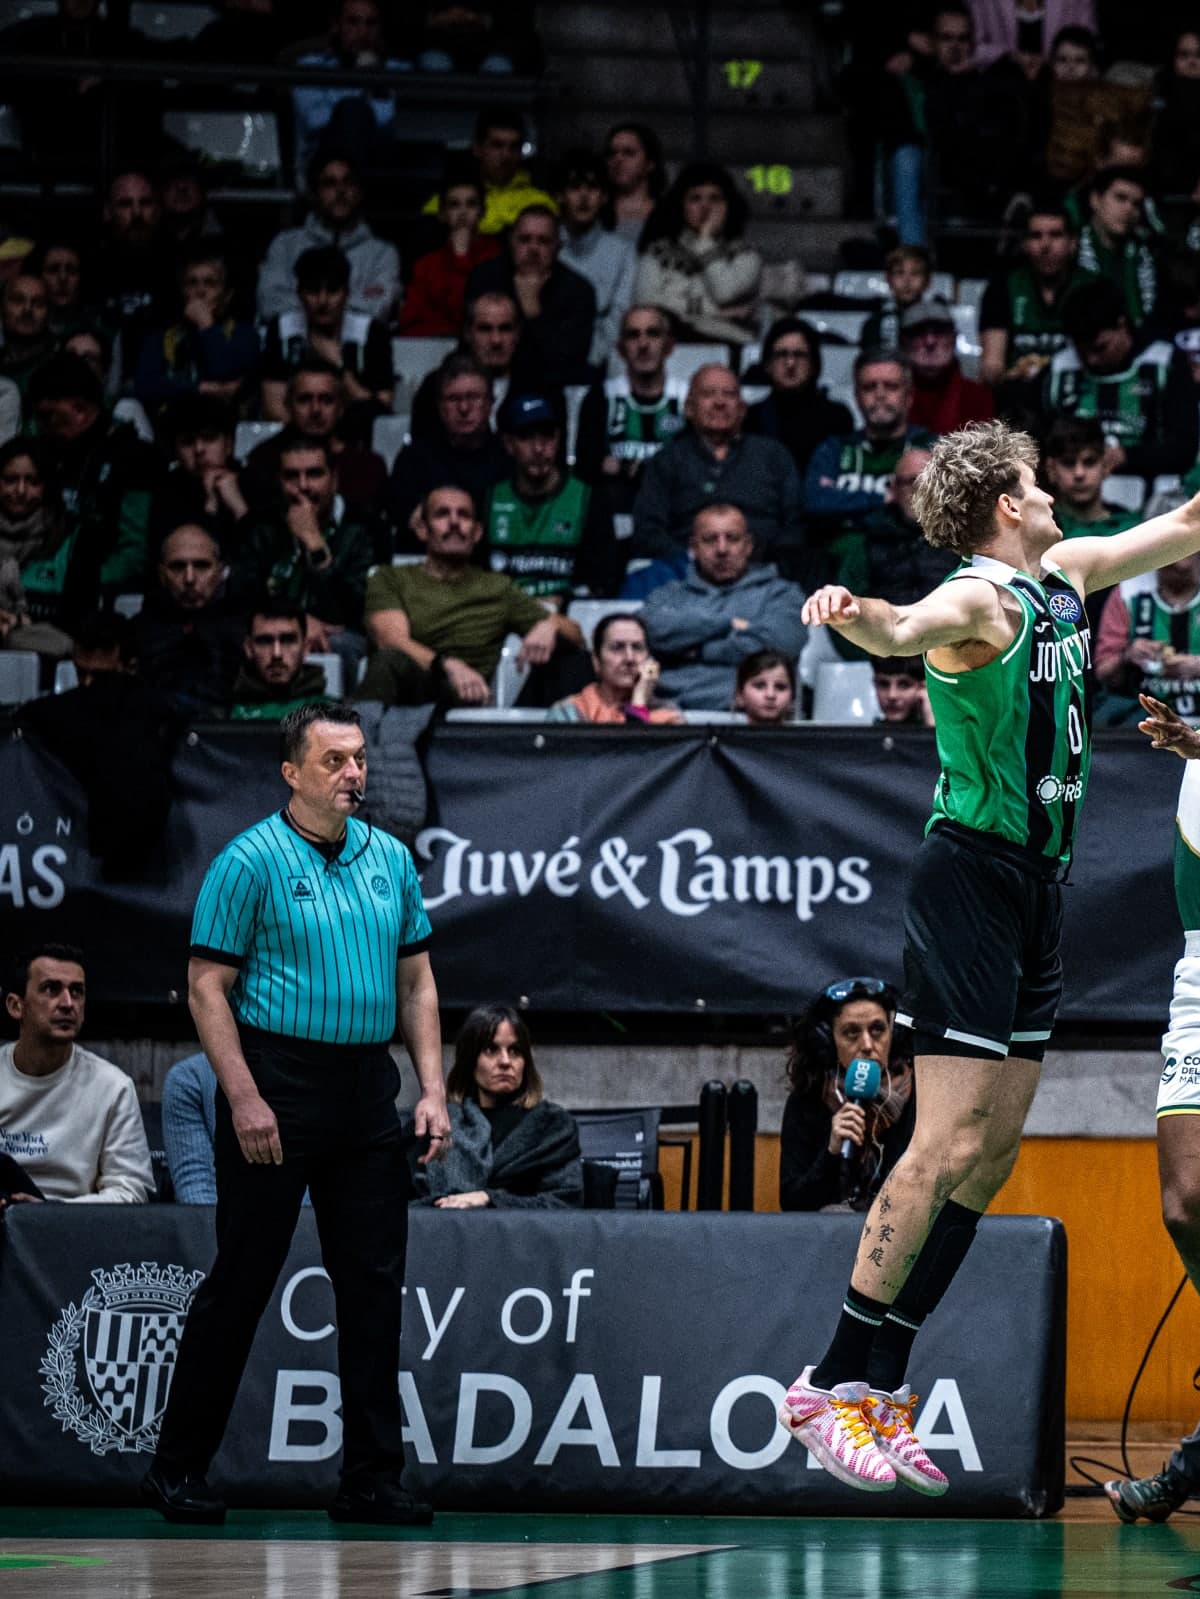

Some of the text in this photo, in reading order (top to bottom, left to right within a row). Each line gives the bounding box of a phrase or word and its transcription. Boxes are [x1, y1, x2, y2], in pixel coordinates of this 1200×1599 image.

[725, 60, 763, 88] 17
[1068, 704, 1083, 755] 0
[414, 827, 873, 921] Juvé & Camps
[852, 1061, 871, 1092] BDN
[1182, 1067, 1200, 1076] DEL
[279, 1266, 595, 1361] Cy of
[268, 1369, 984, 1473] BDALOA
